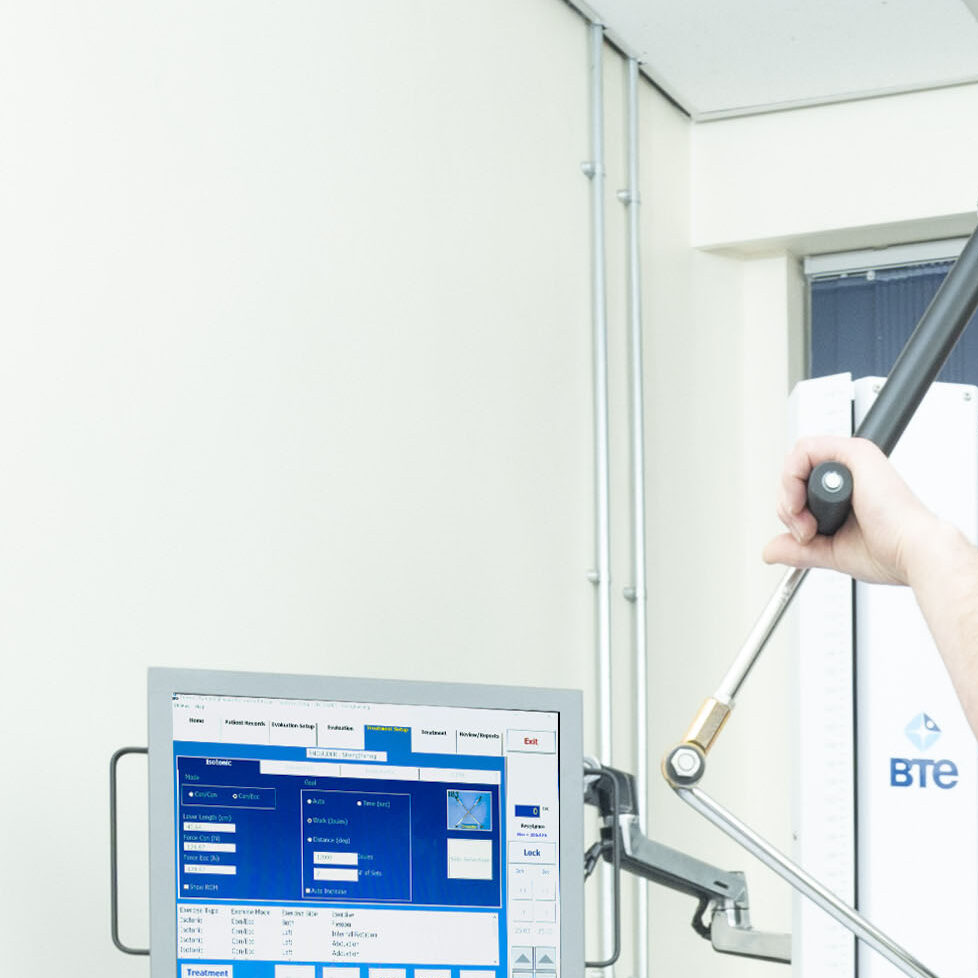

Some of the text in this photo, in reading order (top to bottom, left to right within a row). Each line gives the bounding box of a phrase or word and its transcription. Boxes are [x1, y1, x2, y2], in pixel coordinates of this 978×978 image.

[524, 738, 538, 746] Exit
[206, 759, 232, 767] Isotonic
[532, 807, 538, 816] 0
[524, 849, 541, 857] Lock
[187, 968, 229, 977] Treatment
